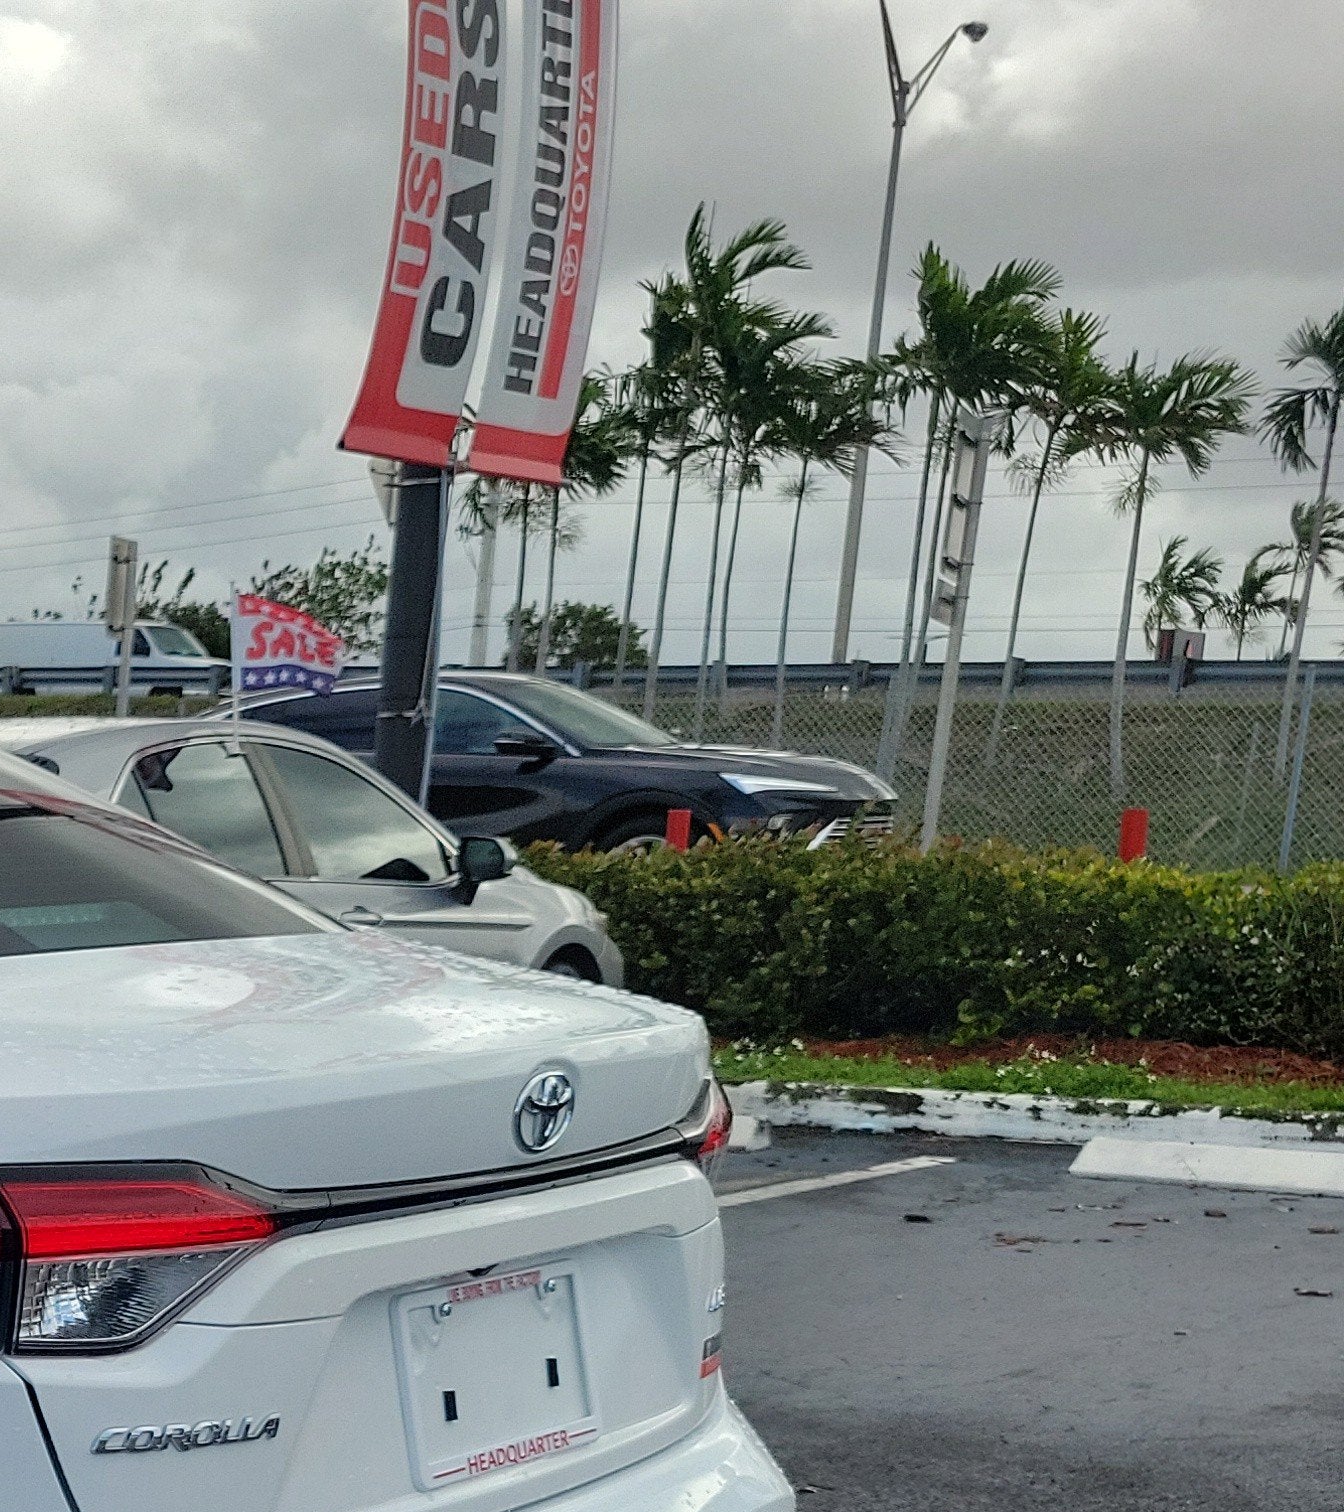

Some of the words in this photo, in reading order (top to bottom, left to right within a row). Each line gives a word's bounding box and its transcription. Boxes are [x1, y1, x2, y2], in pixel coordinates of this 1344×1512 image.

[392, 3, 451, 298] USED
[419, 0, 501, 368] CARS
[569, 70, 596, 232] TOYOTA
[245, 621, 341, 667] SALE
[91, 1412, 280, 1455] COROLLA
[466, 1429, 569, 1476] HEADQUARTER
